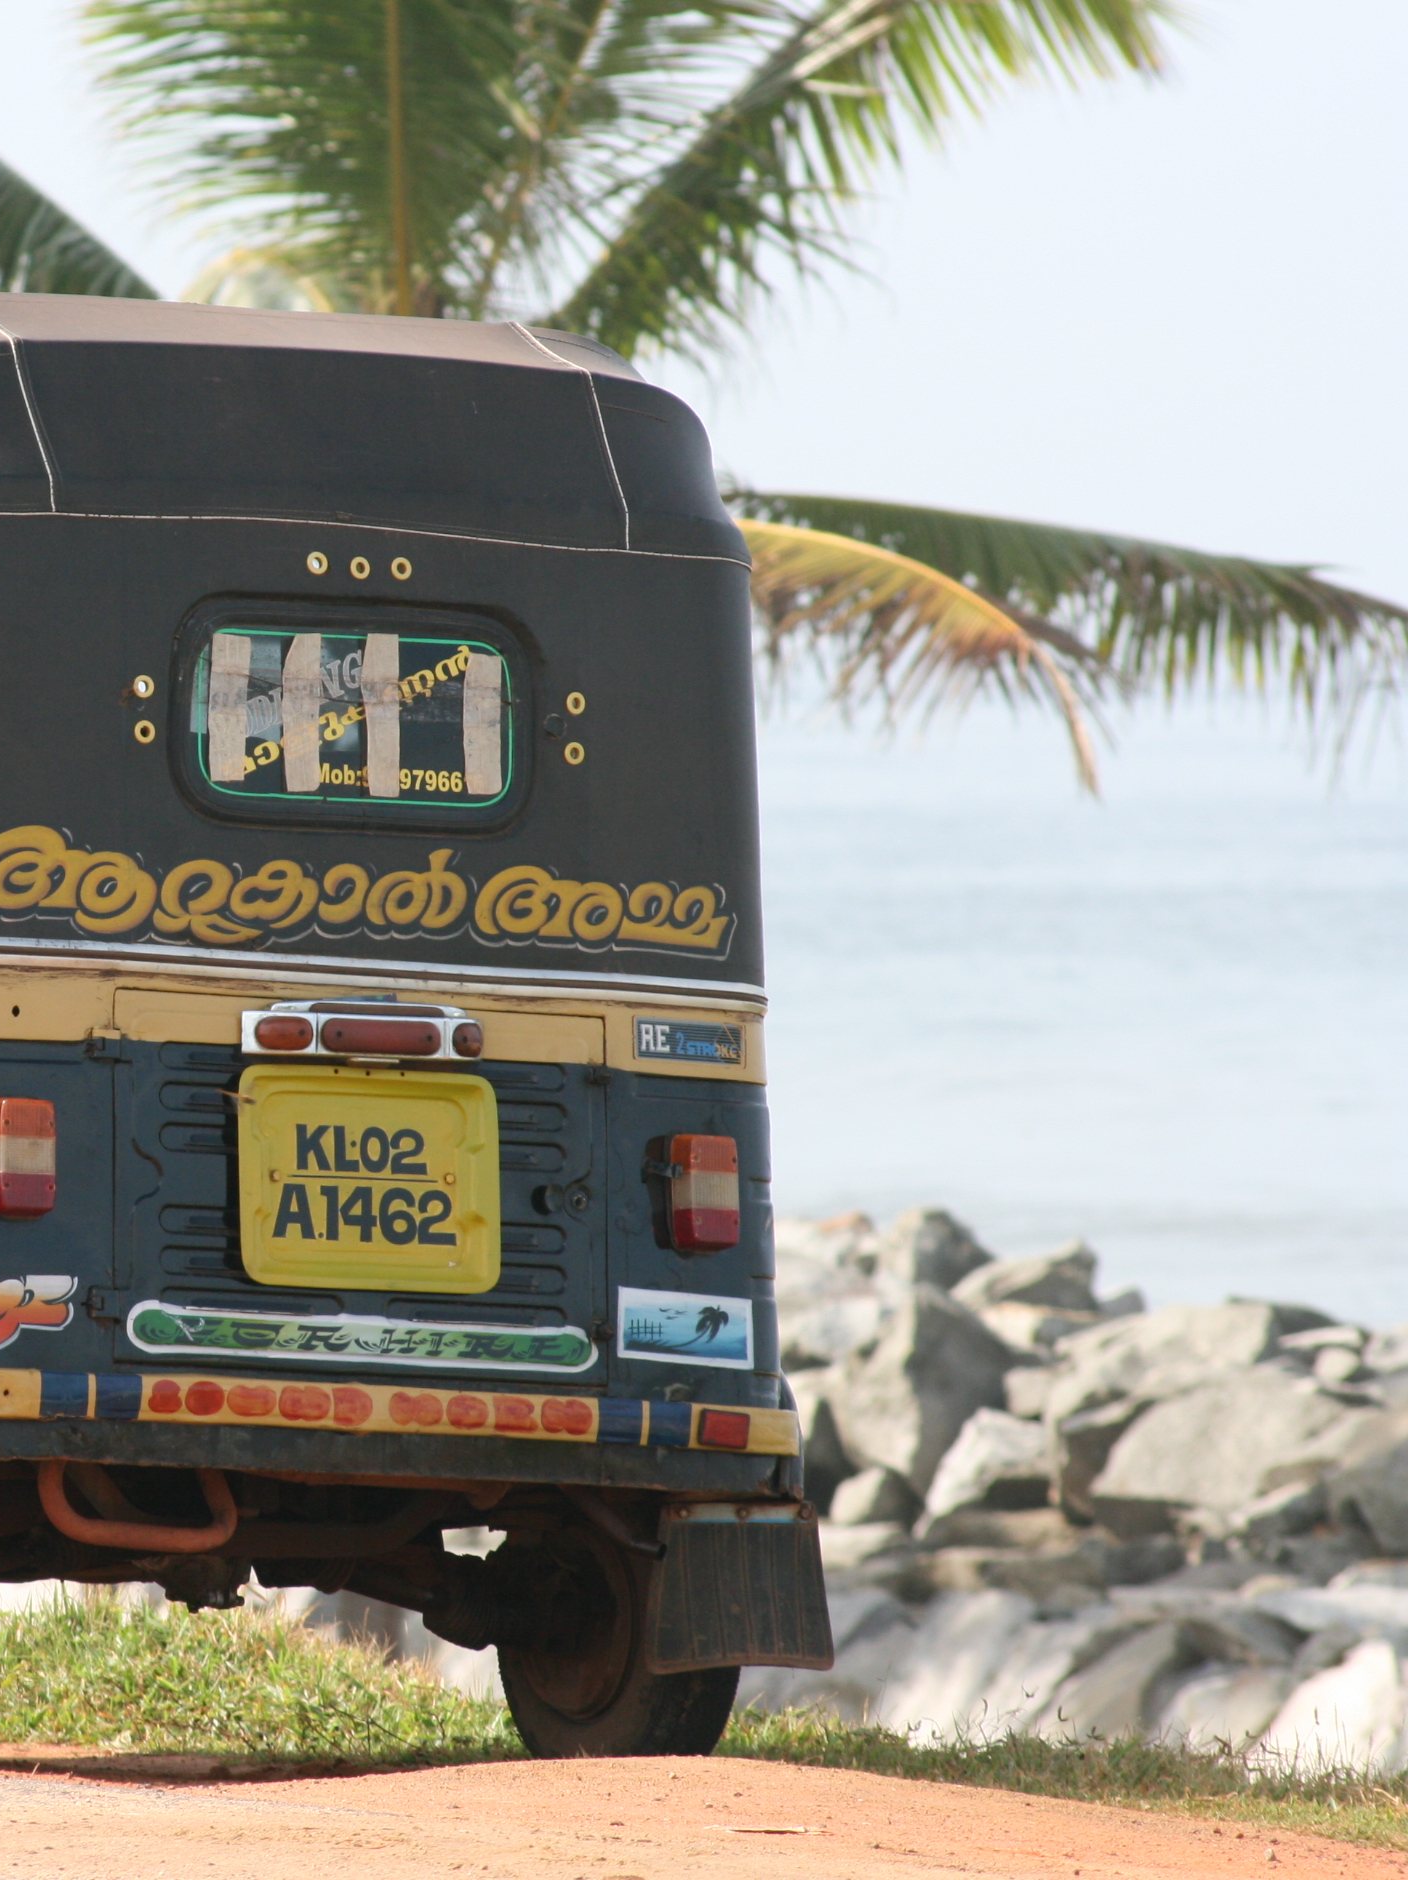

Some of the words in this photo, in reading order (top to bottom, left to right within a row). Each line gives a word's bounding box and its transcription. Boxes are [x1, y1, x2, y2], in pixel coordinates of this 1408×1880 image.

[639, 1023, 671, 1053] RE
[675, 1031, 686, 1055] 2
[271, 1182, 458, 1247] A.1462
[174, 1315, 354, 1353] FOR
[377, 1326, 569, 1366] HIRE
